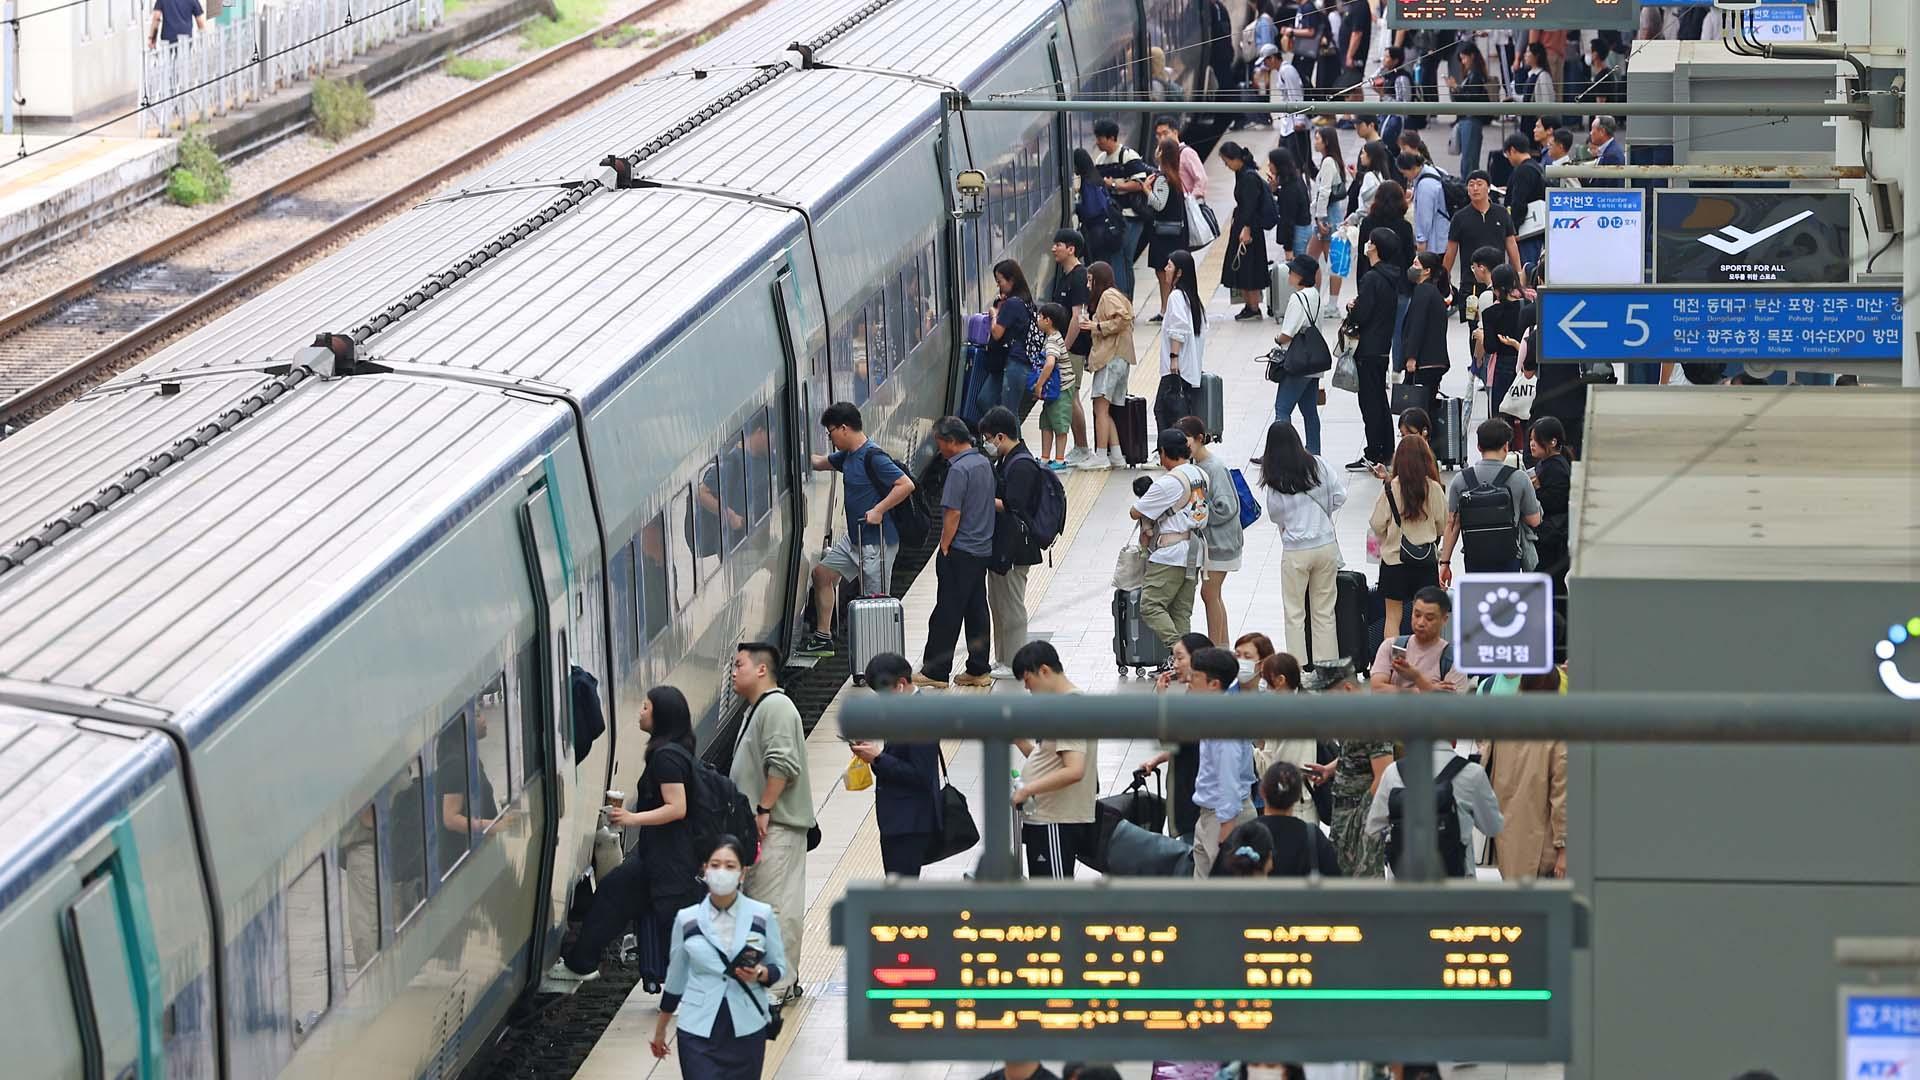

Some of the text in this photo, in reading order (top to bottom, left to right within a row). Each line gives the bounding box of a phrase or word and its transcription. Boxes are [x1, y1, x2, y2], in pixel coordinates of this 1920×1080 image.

[1552, 196, 1594, 208] 호차번호
[1553, 216, 1586, 229] KTX
[1673, 298, 1699, 313] 대전
[1706, 298, 1746, 314] 동대구
[1754, 298, 1781, 313] 부산
[1788, 298, 1815, 313] 포항
[1823, 298, 1848, 313] 진주
[1856, 298, 1882, 313] 마산
[1623, 303, 1650, 347] 5
[1673, 328, 1899, 345] 익산 광주송정 목포 여수EXPO 방면
[1478, 645, 1529, 663] 편의점
